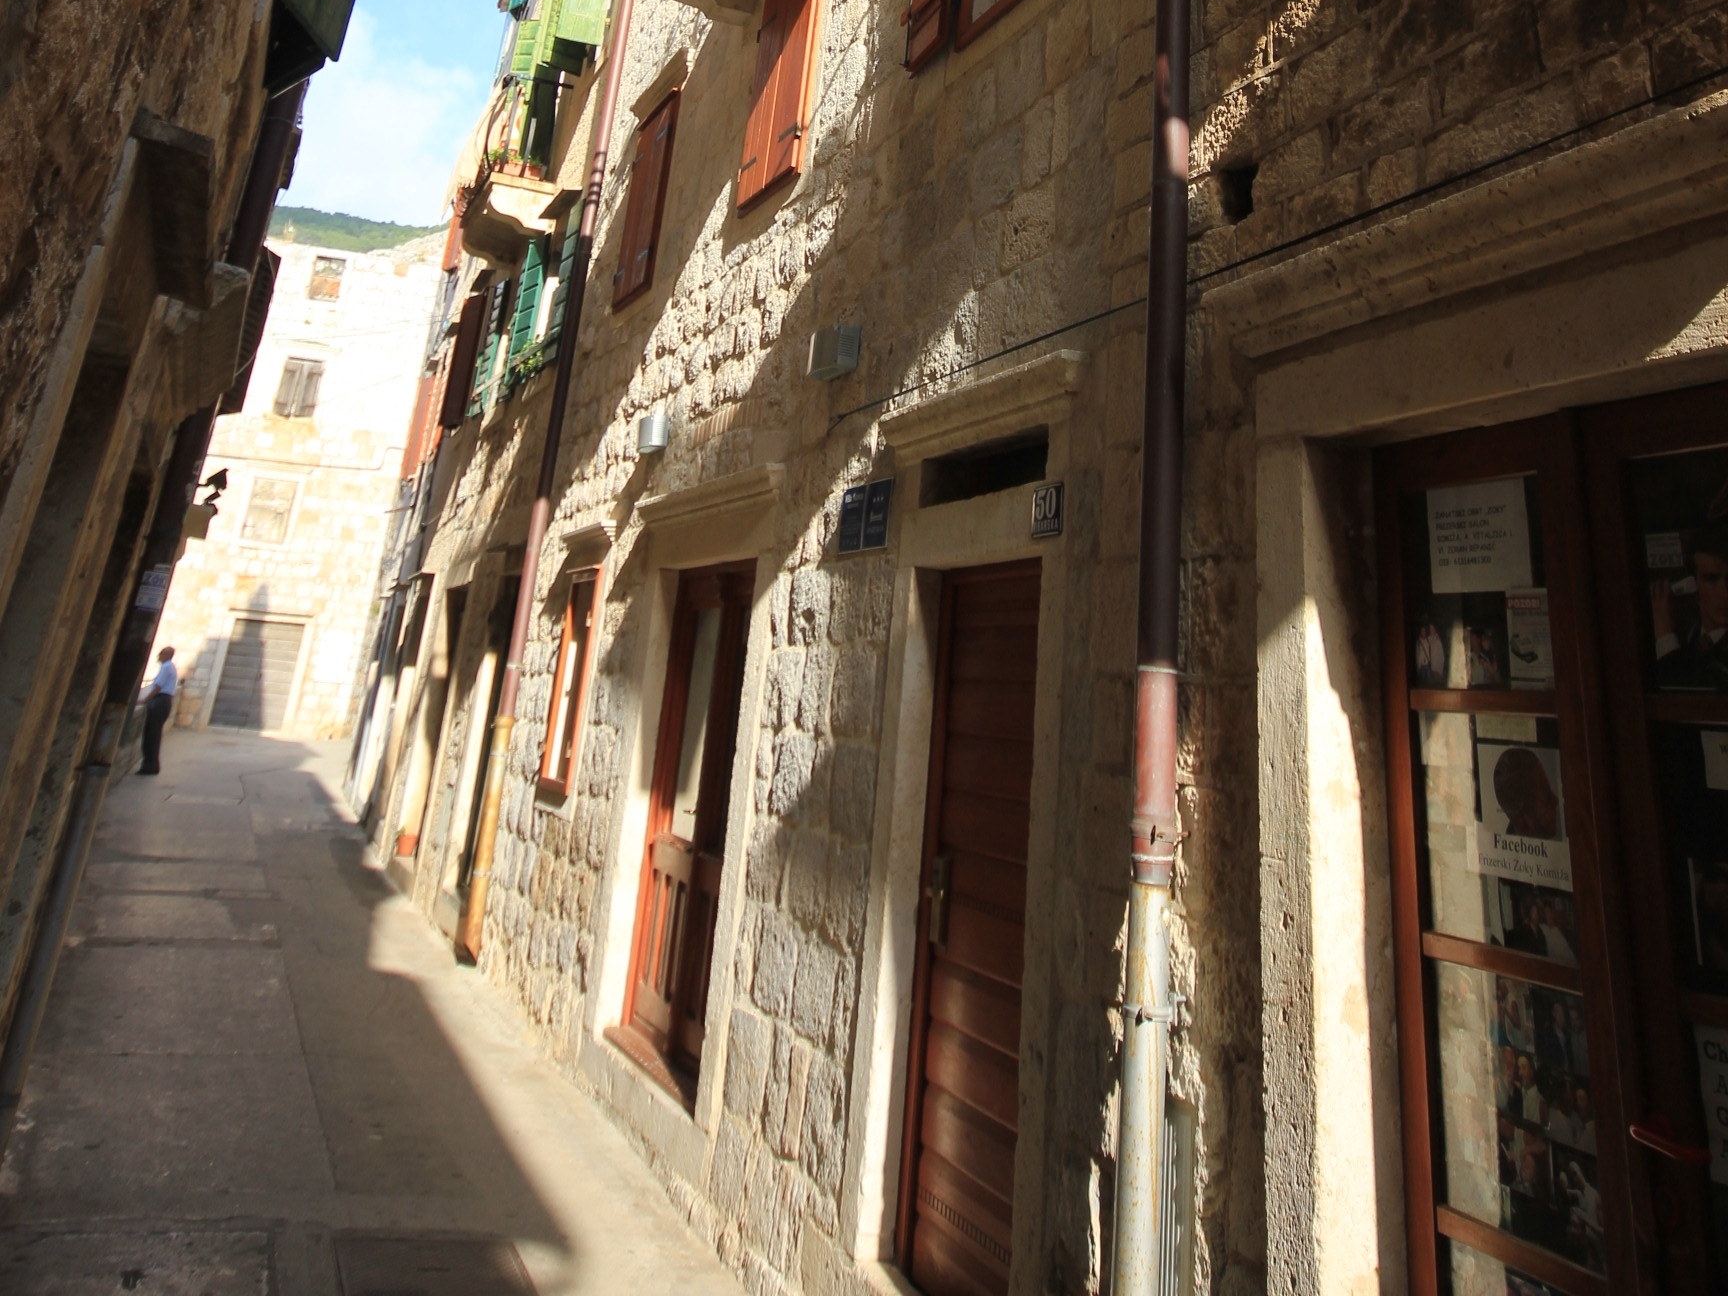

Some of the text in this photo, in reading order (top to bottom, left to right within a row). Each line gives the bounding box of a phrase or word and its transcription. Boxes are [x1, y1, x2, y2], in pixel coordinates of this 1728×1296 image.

[1035, 488, 1056, 520] 50
[1507, 598, 1540, 609] POZOR!
[1493, 832, 1549, 858] Facebook
[1479, 852, 1511, 871] Frizerski
[1513, 859, 1534, 878] Zoky
